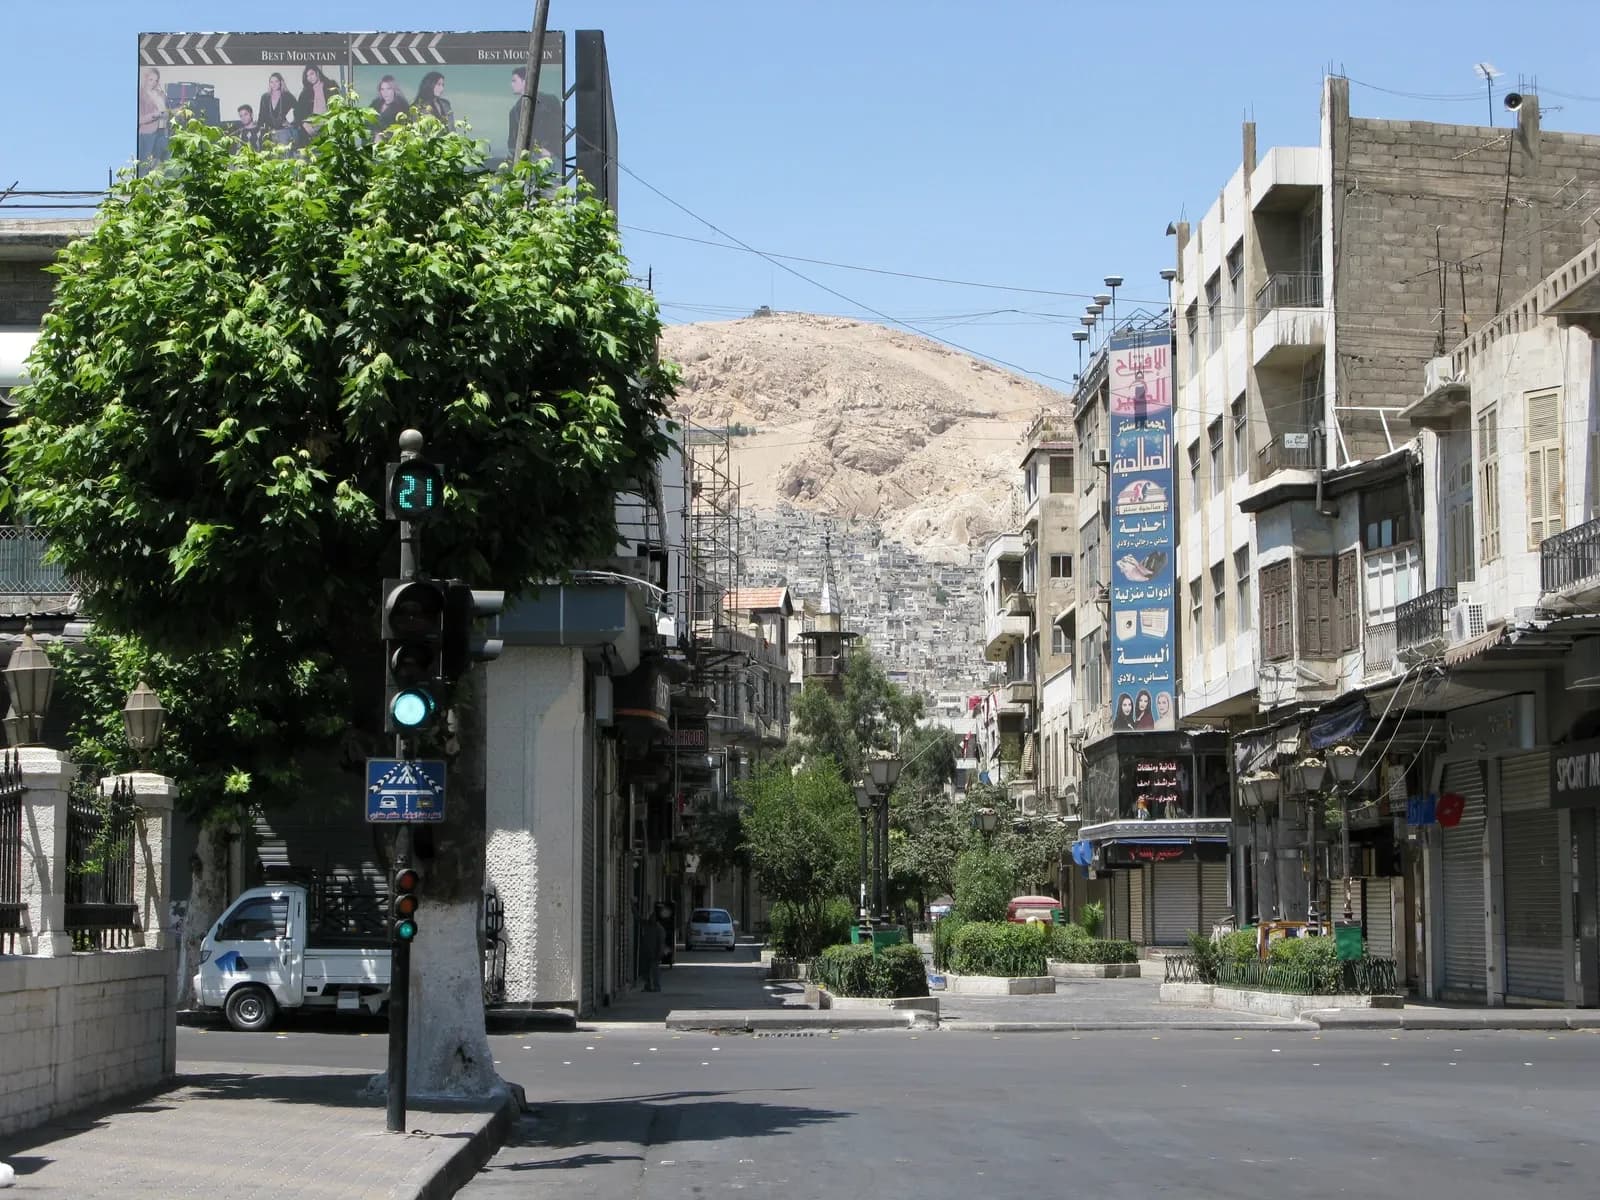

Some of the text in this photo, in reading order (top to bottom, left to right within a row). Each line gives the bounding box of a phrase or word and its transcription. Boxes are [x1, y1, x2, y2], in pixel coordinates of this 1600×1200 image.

[261, 50, 336, 61] BEST MOUNTAIN
[478, 49, 552, 60] BEST MOUNIN
[399, 475, 432, 509] 21
[1114, 586, 1144, 603] منزلية
[1557, 754, 1586, 792] SPORT
